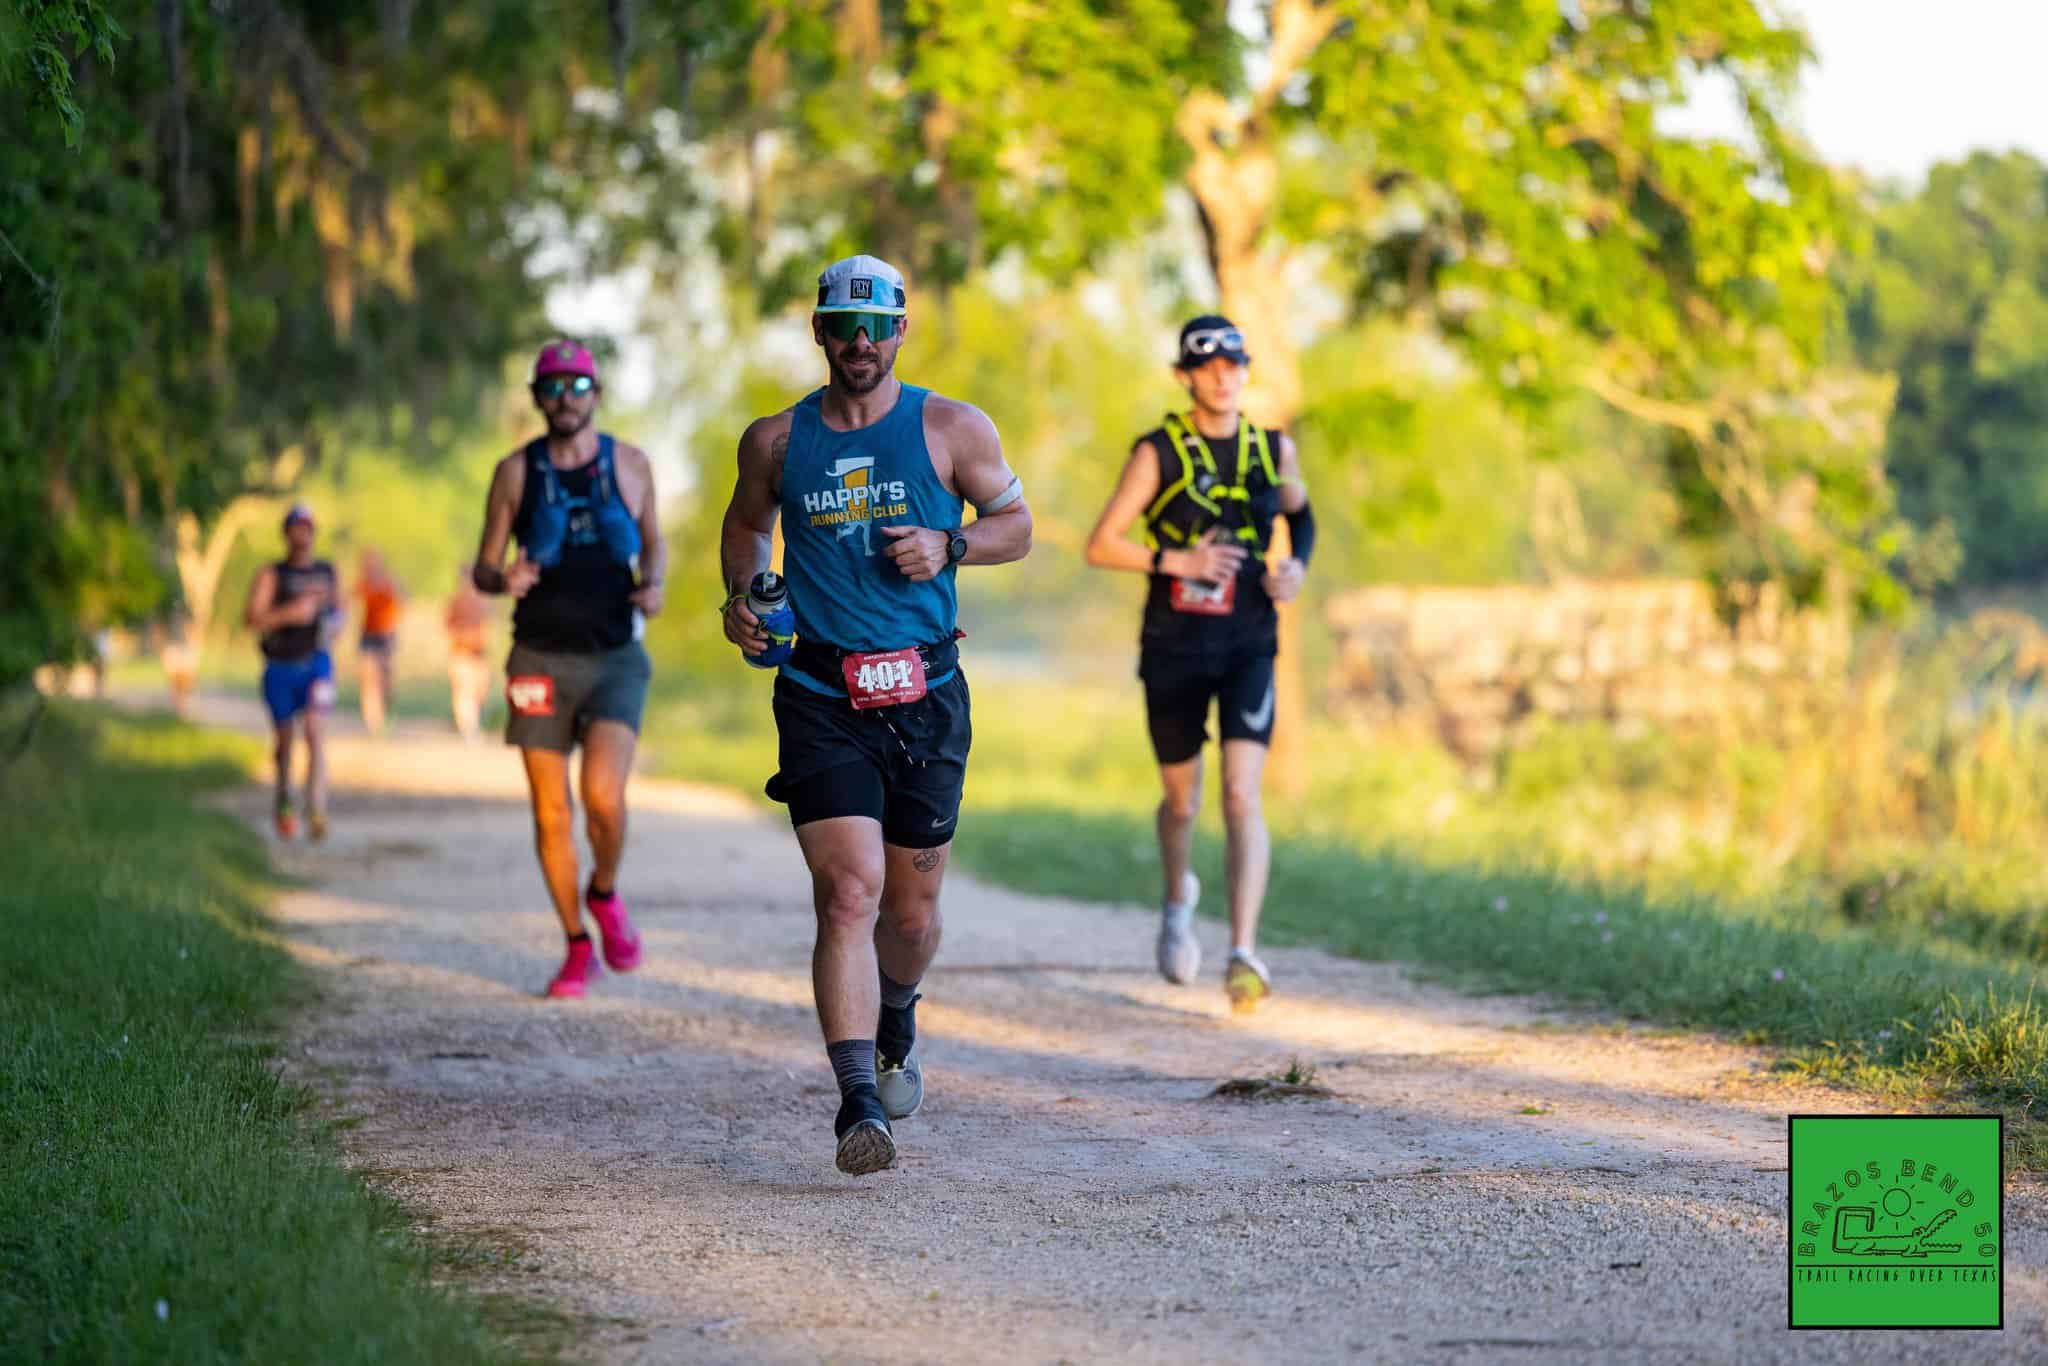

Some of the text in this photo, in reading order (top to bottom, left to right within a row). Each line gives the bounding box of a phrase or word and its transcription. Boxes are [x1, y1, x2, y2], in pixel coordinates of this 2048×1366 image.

[803, 481, 905, 513] HAPPY'S
[810, 503, 907, 526] RUNNING CLUB
[858, 660, 912, 693] 401
